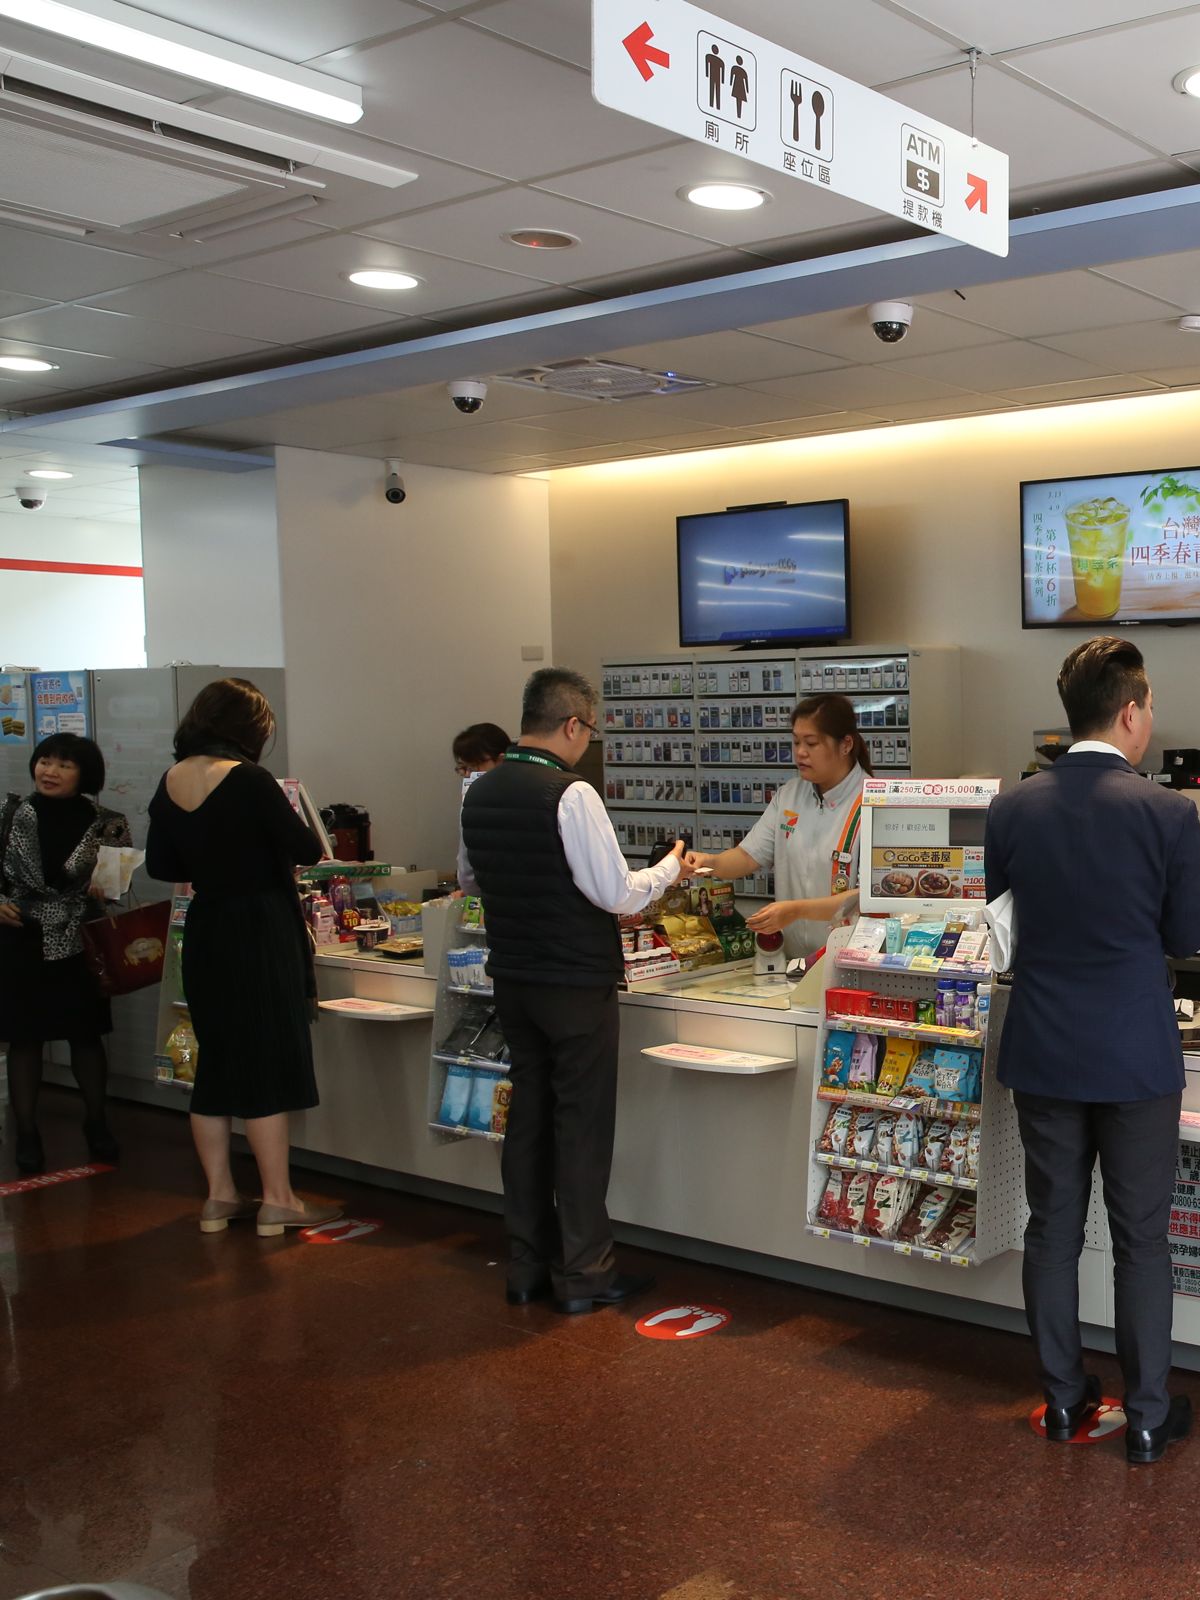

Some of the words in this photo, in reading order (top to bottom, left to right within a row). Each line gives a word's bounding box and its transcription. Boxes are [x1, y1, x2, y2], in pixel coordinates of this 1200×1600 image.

[704, 120, 750, 154] 廁所
[907, 133, 941, 164] ATM
[782, 152, 831, 185] 座位區
[902, 198, 943, 230] 提款機
